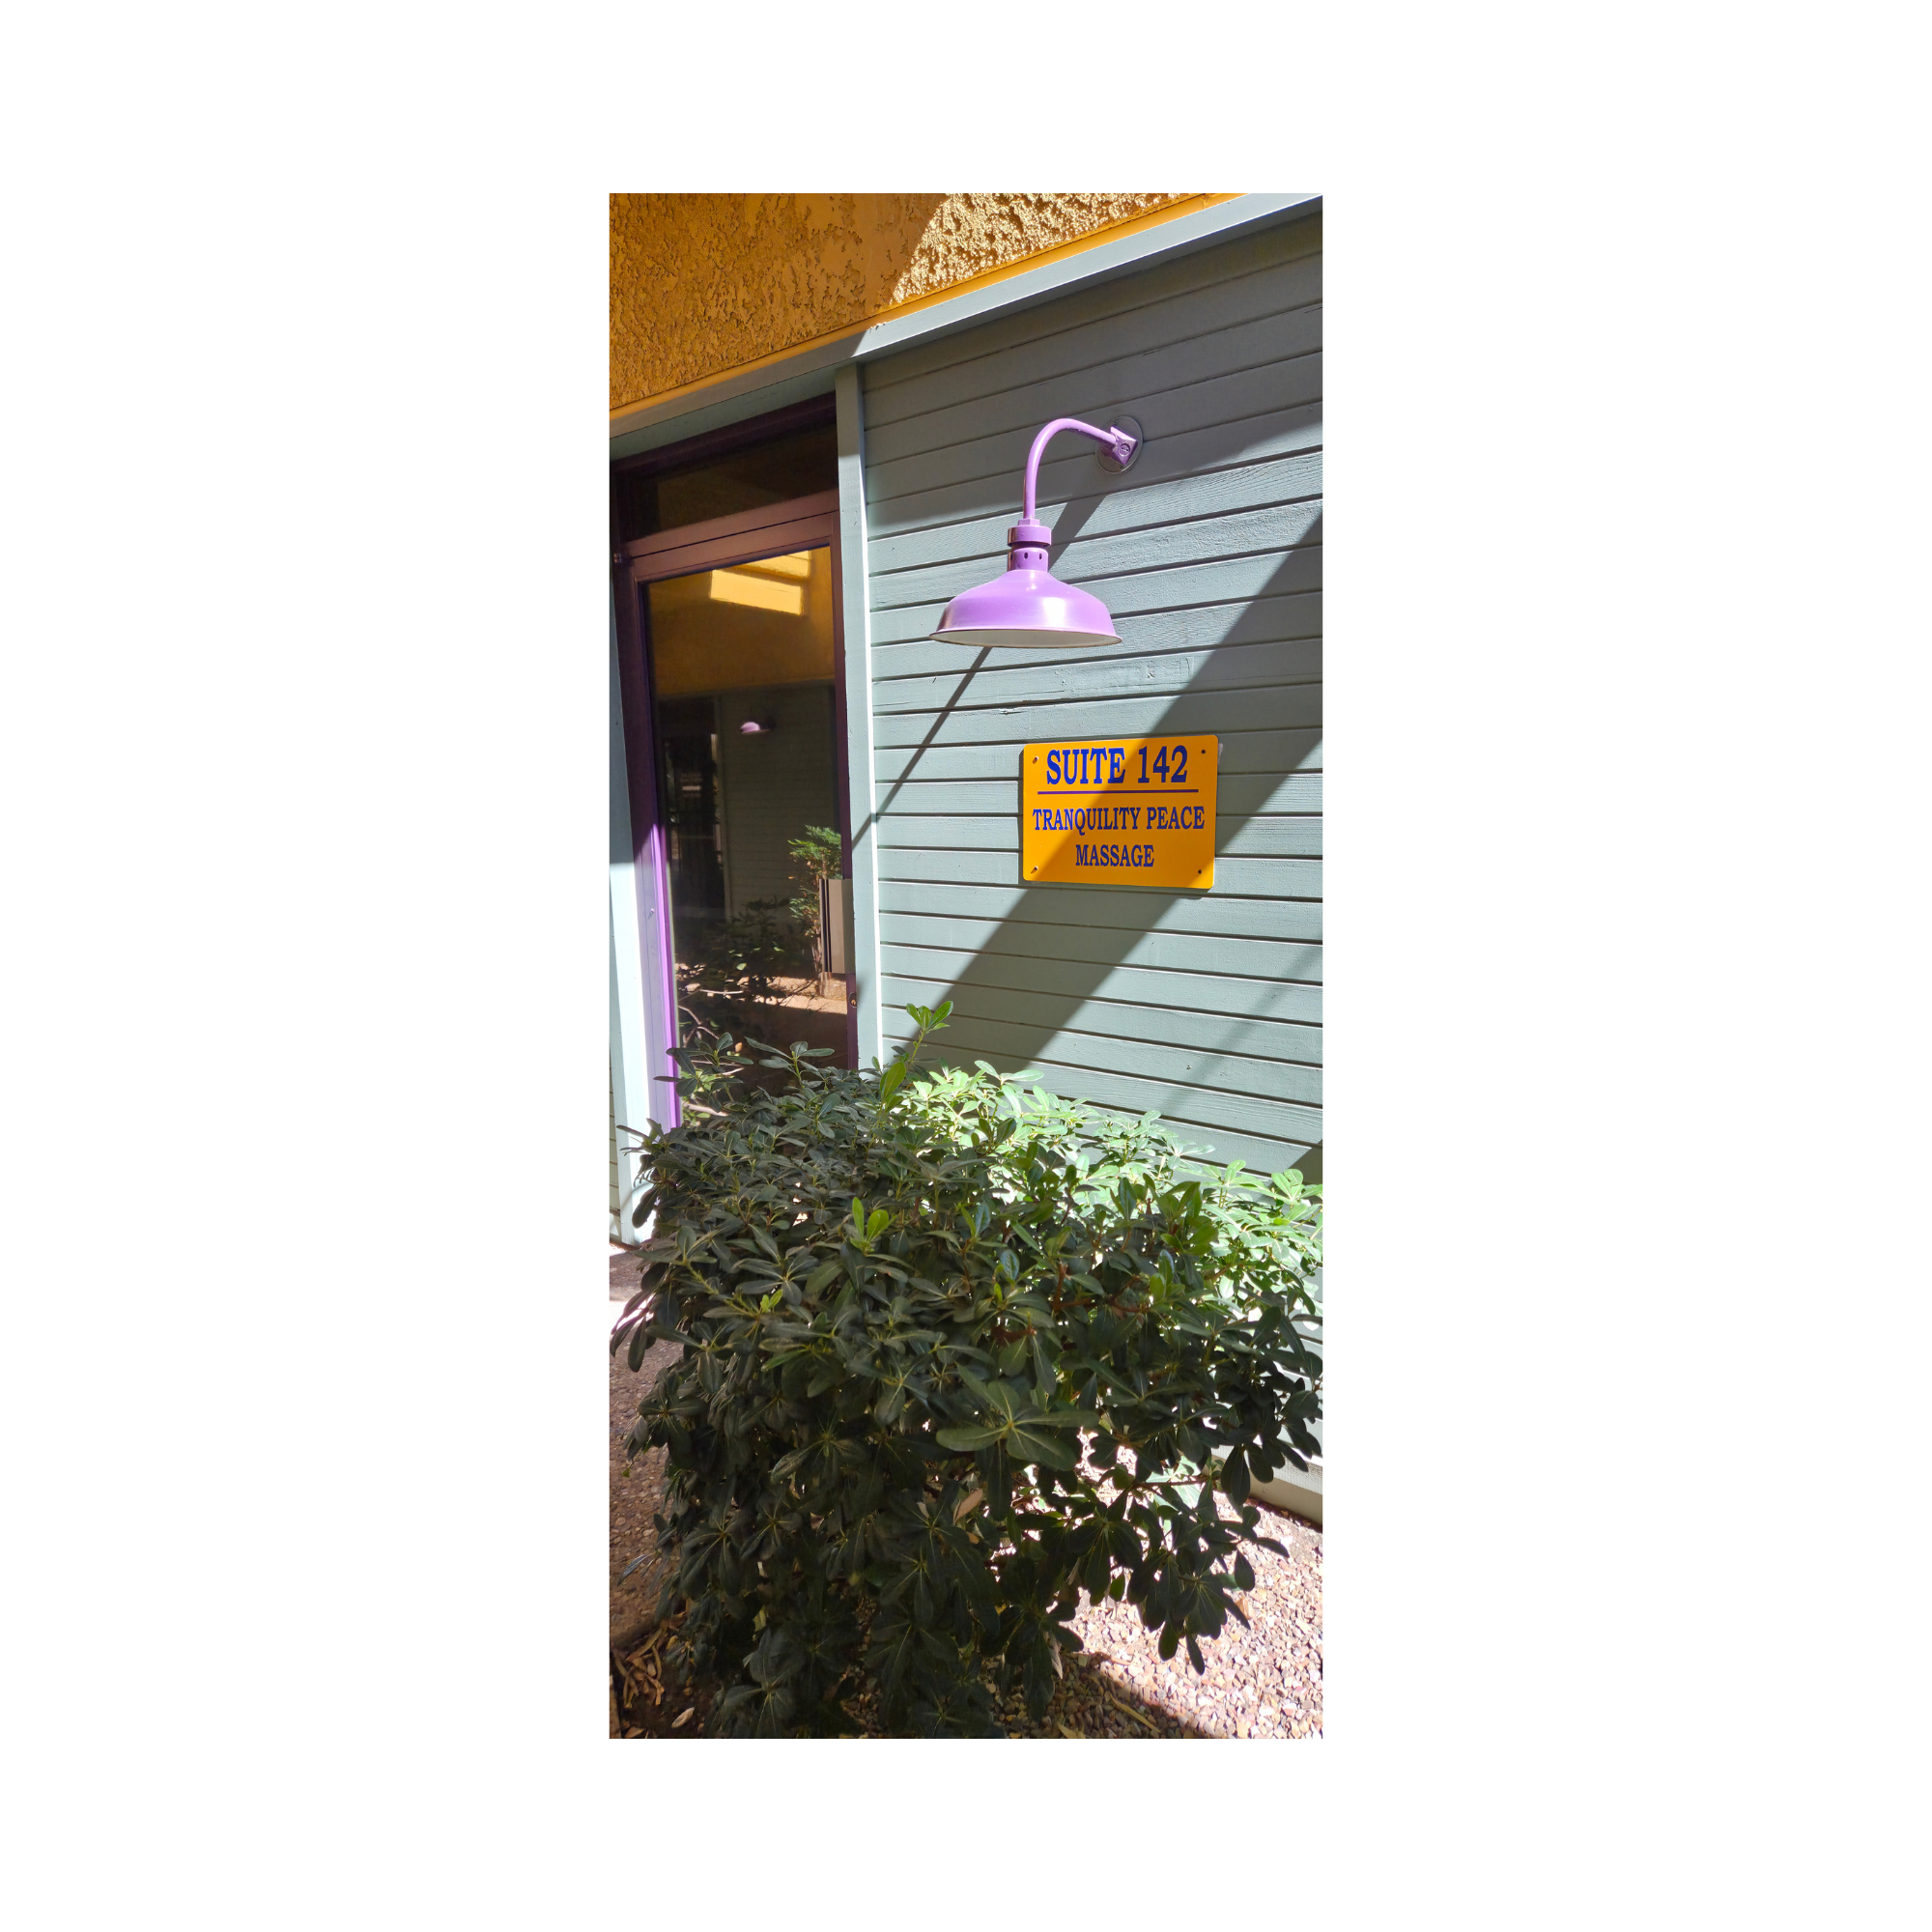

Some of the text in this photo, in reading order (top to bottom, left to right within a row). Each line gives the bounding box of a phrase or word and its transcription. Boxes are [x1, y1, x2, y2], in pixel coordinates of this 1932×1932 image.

[1046, 746, 1188, 784] SUITE 142
[1033, 806, 1205, 836] TRANQUILITY PEACE
[1075, 844, 1154, 867] MASSAGE
